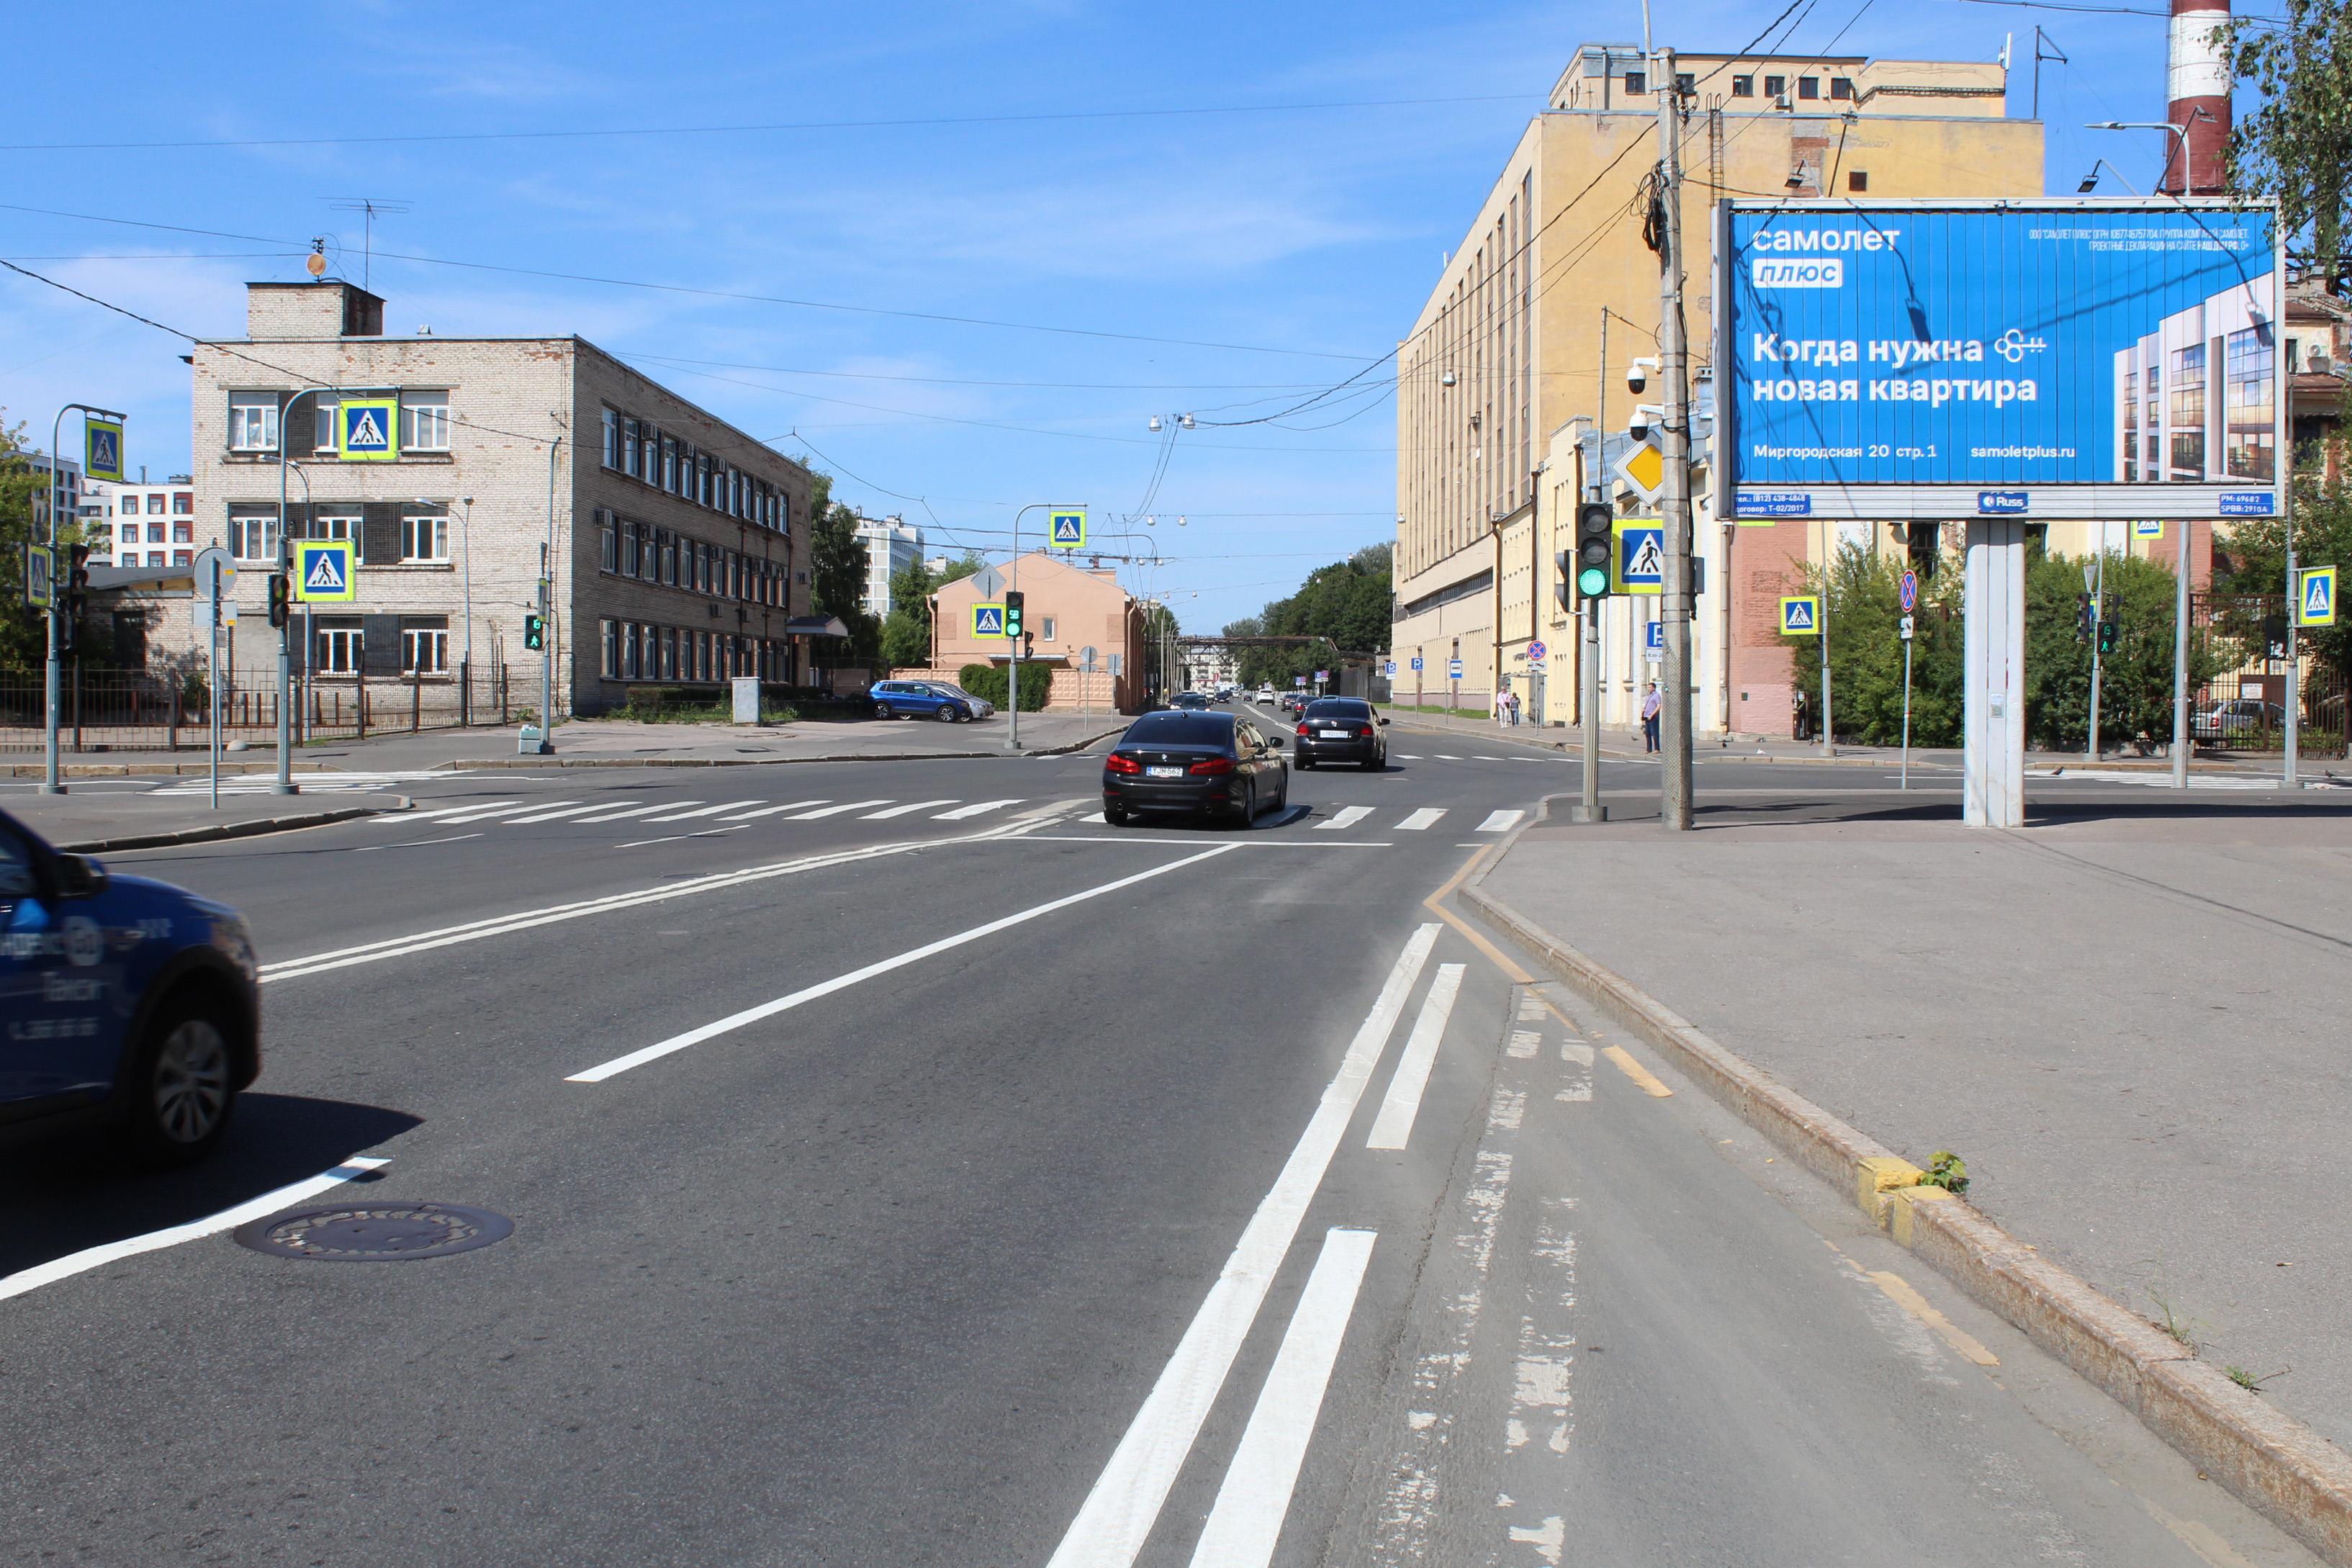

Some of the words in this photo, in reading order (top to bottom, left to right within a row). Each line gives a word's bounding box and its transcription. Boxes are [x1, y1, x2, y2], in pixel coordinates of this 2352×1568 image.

[1752, 230, 1901, 252] самолет
[2029, 229, 2042, 239] ООО
[2166, 240, 2176, 251] НА
[1754, 333, 1858, 366] Когда
[1868, 340, 1983, 369] нужна
[1754, 379, 1858, 401] новая
[1869, 379, 2037, 408] квартира
[1754, 445, 1862, 460] Миргородская
[1868, 444, 1890, 458] 20
[1970, 444, 2076, 460] samoletplus.ru
[1996, 496, 2024, 507] Russ
